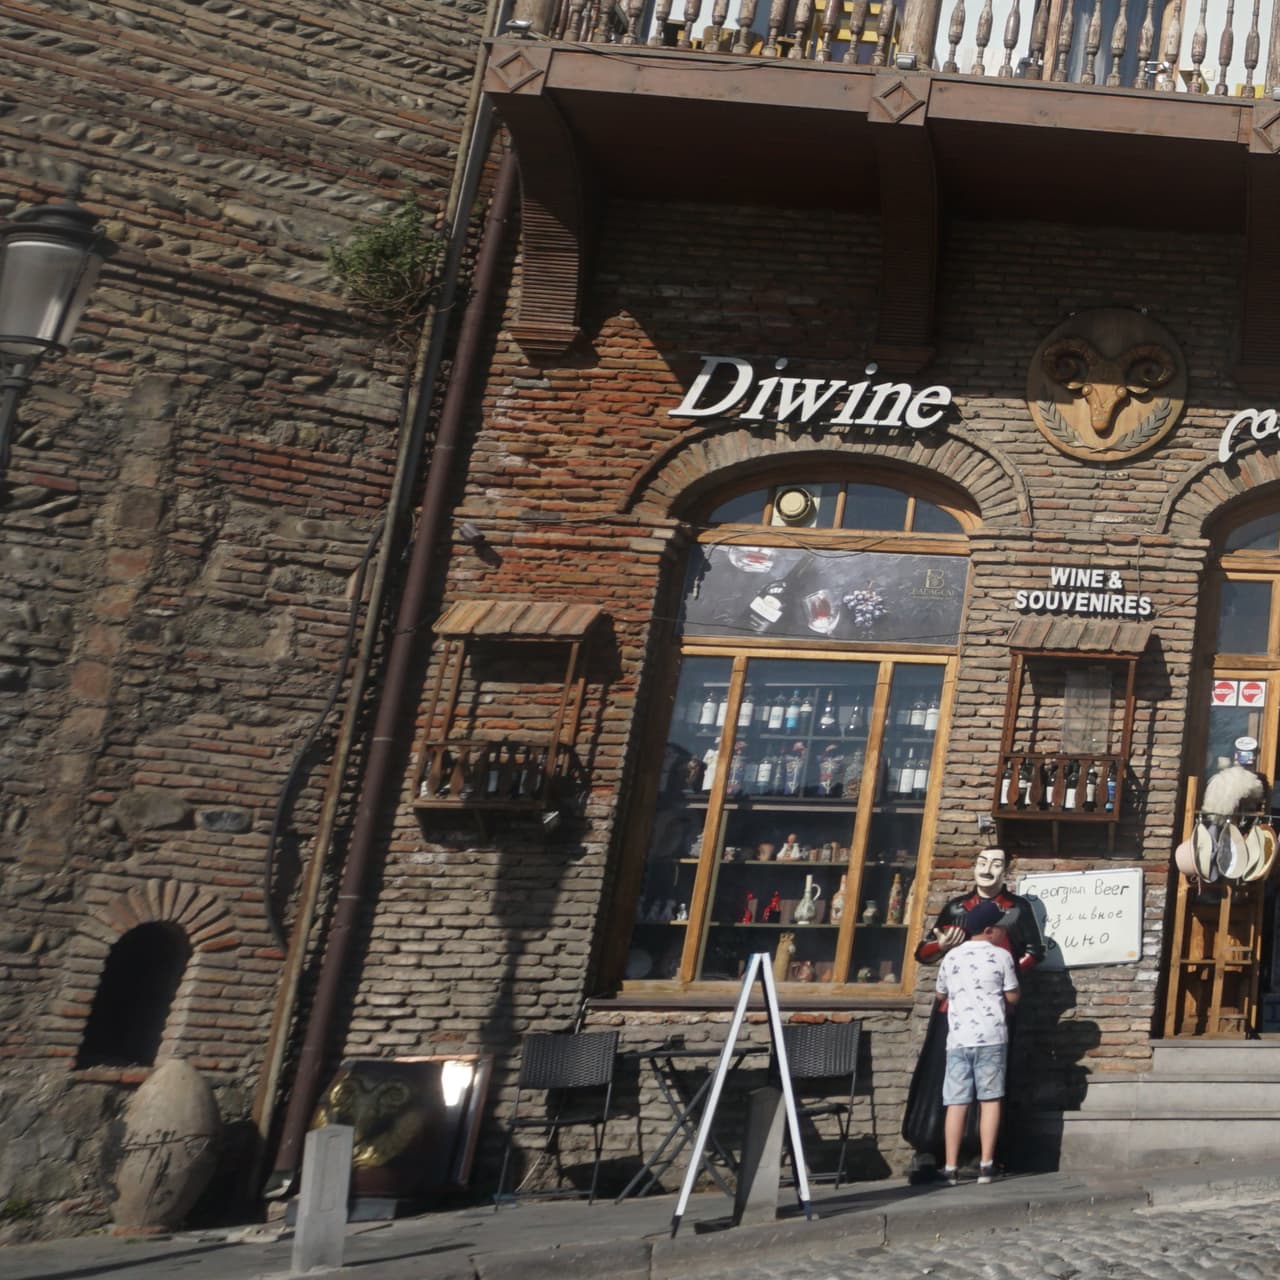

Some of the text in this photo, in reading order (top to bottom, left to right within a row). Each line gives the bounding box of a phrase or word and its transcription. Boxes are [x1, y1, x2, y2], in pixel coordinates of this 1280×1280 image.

[667, 355, 952, 429] Diwine
[1050, 567, 1122, 589] WINE &
[1014, 590, 1152, 615] SOUVENIRES
[1026, 878, 1130, 904] Georgian Beer
